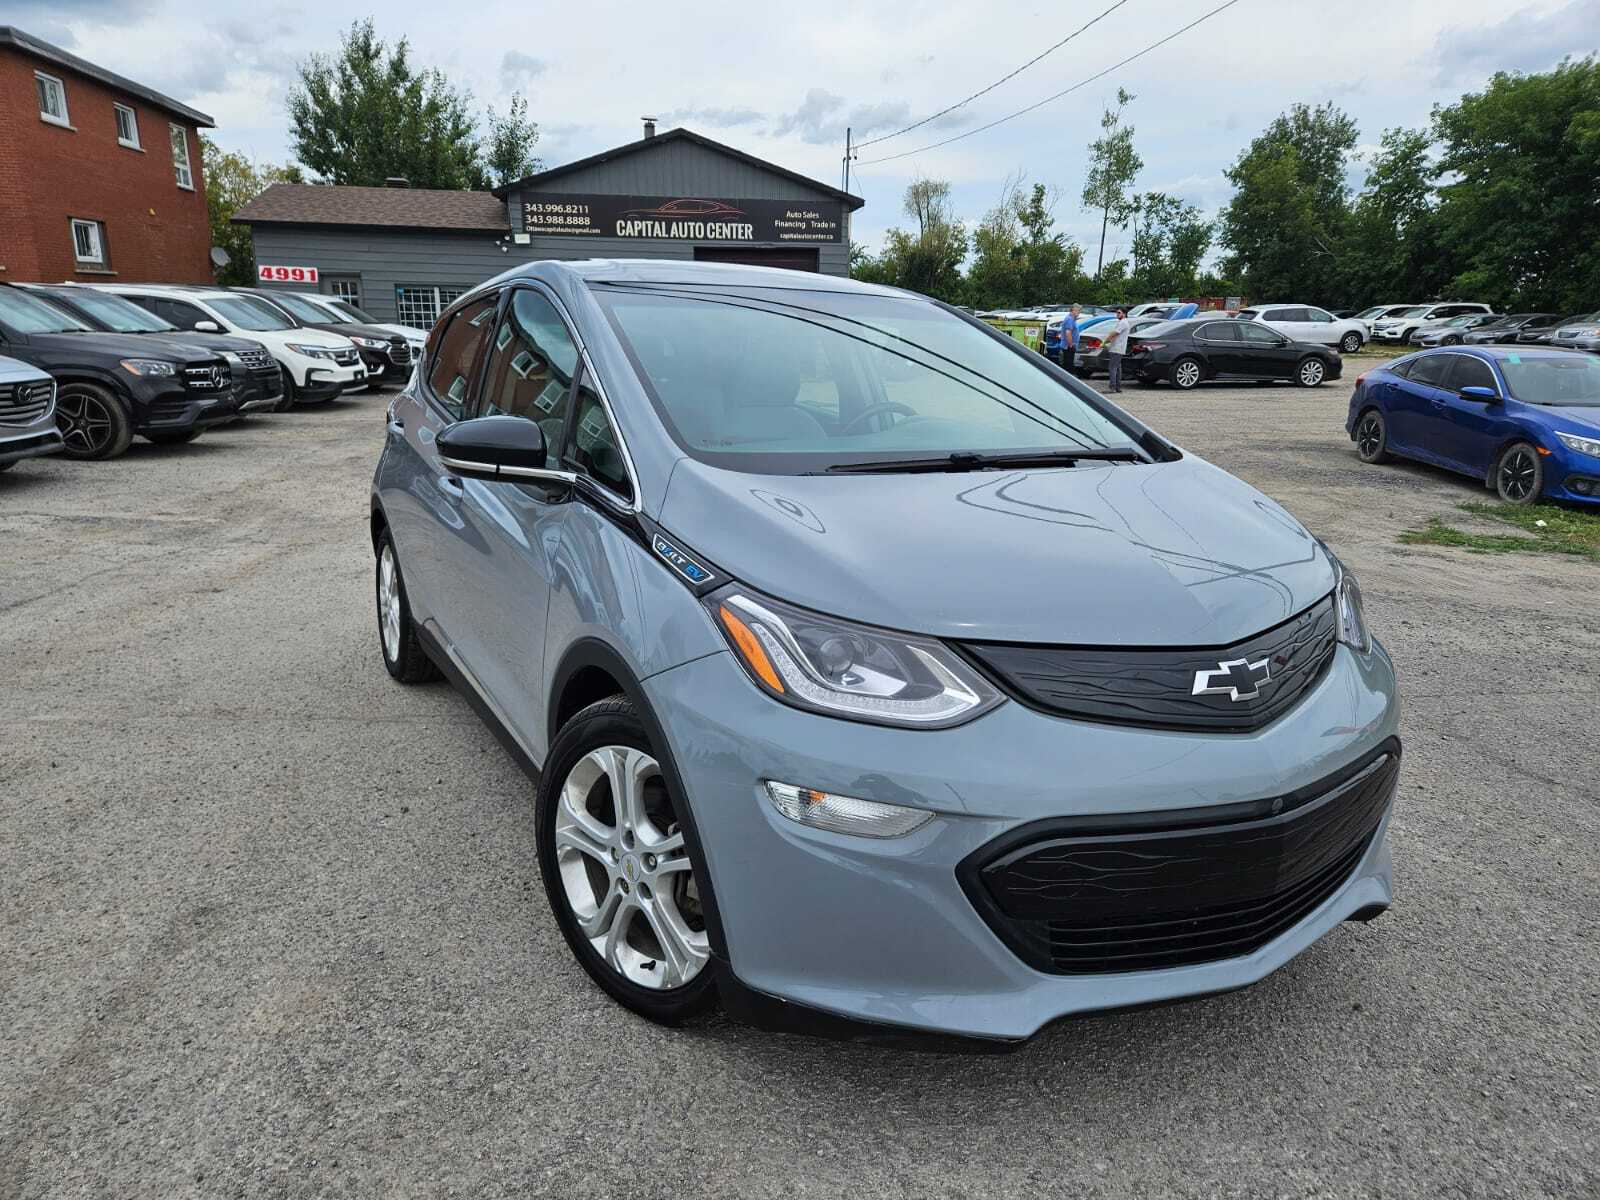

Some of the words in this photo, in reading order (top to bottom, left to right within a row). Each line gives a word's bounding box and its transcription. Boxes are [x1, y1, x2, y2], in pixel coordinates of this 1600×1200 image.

[525, 203, 589, 214] 343.996.8211
[525, 214, 591, 225] 343.988.8888
[786, 210, 801, 218] Auto
[802, 211, 820, 219] Sales
[616, 219, 669, 237] CAPITAL
[670, 221, 705, 239] AUTO
[706, 222, 754, 240] CENTER
[774, 220, 806, 229] Financing
[811, 221, 829, 229] Trade
[260, 267, 317, 281] 4991
